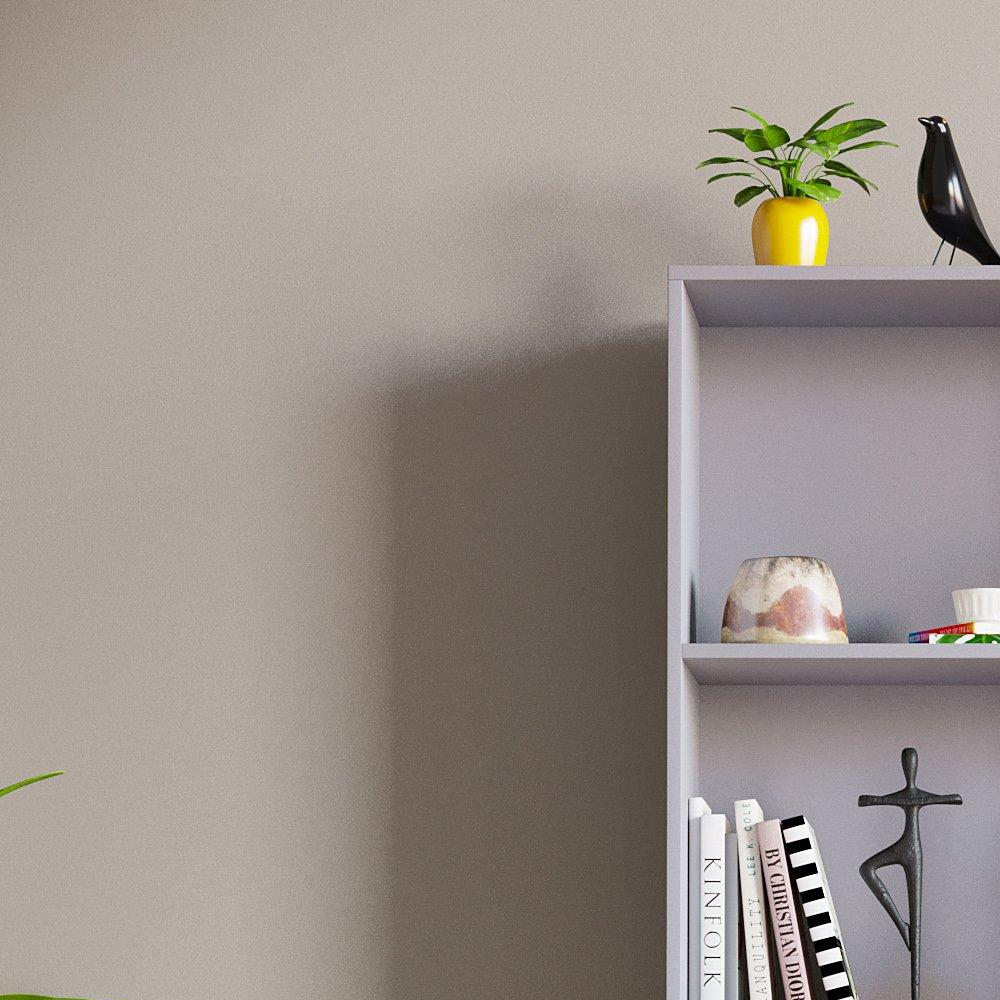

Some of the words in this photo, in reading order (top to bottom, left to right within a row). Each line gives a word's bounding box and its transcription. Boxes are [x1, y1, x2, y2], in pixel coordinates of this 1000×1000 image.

[742, 802, 752, 831] COLE
[747, 855, 756, 876] LEE
[765, 848, 782, 873] BY
[703, 857, 721, 987] KINFOLK
[770, 873, 798, 958] CHRISTIAN
